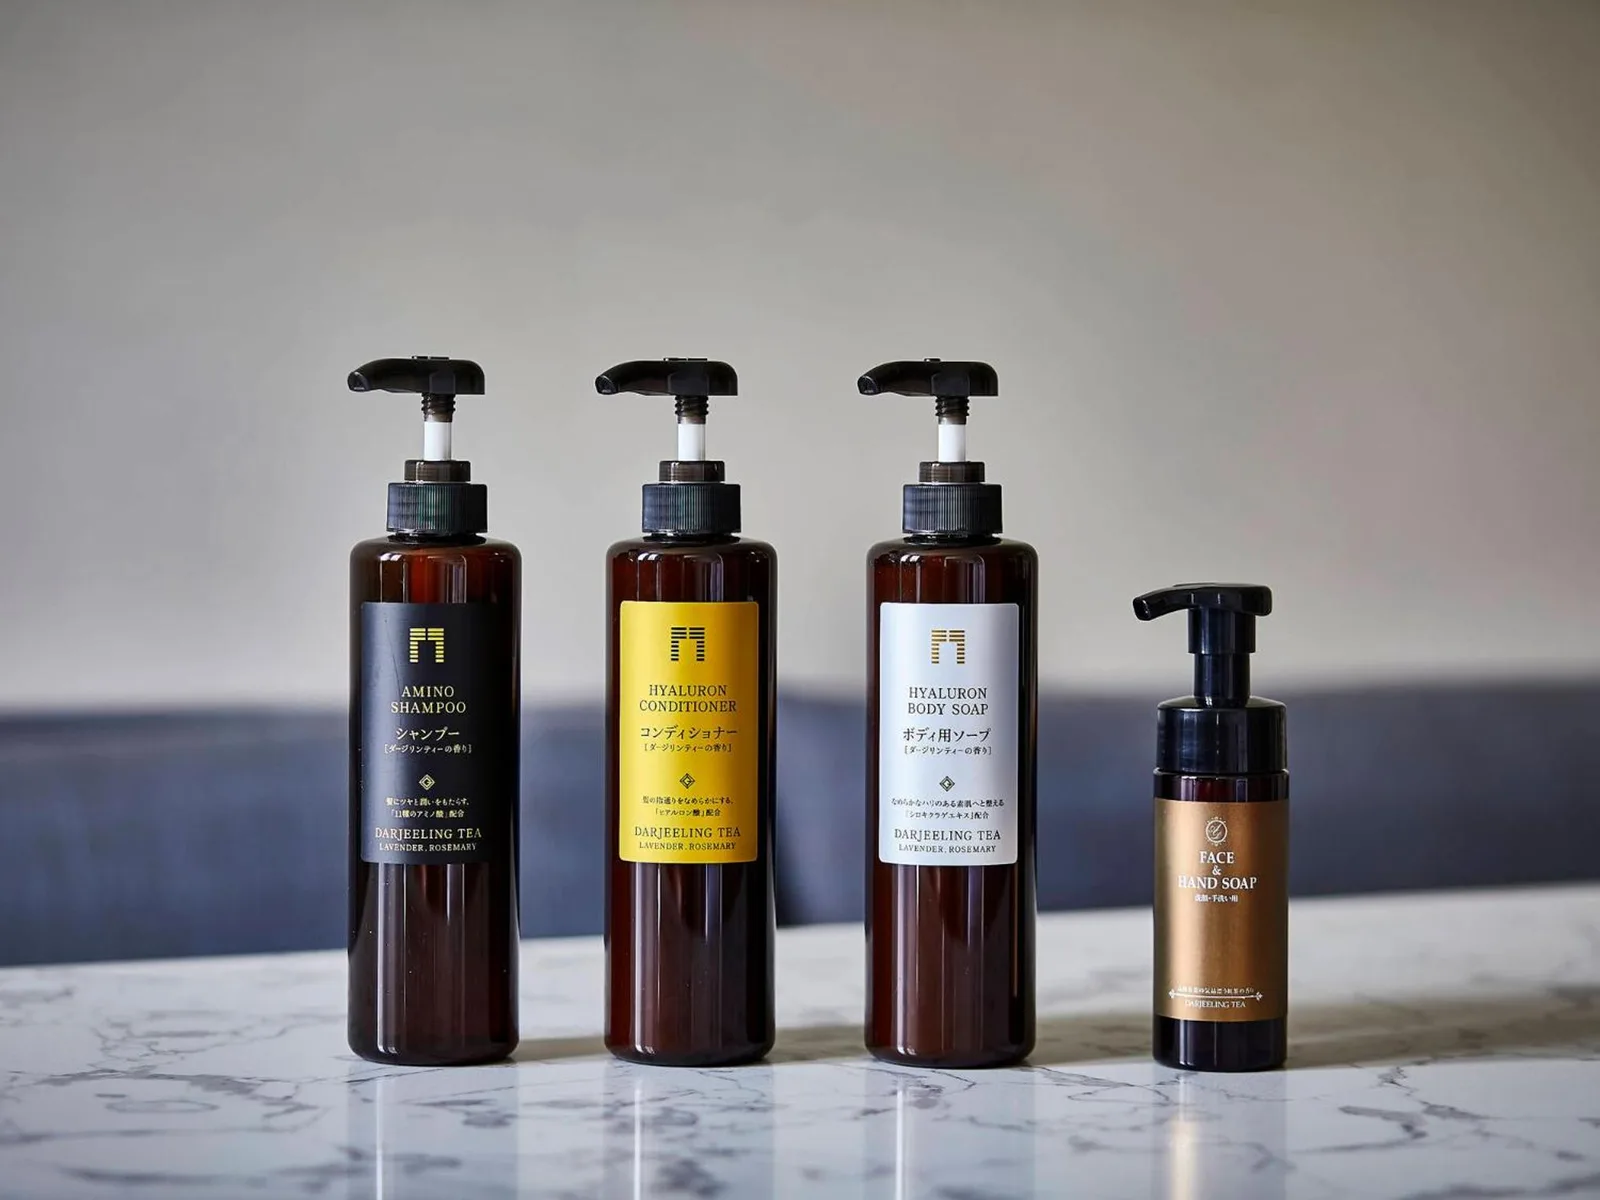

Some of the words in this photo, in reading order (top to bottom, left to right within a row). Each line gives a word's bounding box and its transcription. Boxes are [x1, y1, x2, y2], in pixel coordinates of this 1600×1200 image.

[401, 685, 455, 698] AMINO
[649, 685, 728, 697] HYALURON
[909, 686, 988, 700] HYALURON
[390, 701, 467, 714] SHAMPOO
[639, 700, 737, 713] CONDITIONER
[908, 702, 947, 716] BODY
[951, 703, 989, 716] SOAP
[395, 726, 460, 741] シャンプー
[640, 724, 738, 740] コンディショナー
[902, 726, 992, 743] ボディ用ソープ
[375, 827, 453, 841] DARJEELING
[457, 828, 482, 839] TEA
[634, 826, 713, 839] DARJEELING
[717, 827, 742, 838] TEA
[894, 828, 972, 842] DARJEELING
[976, 830, 1001, 841] TEA
[429, 843, 477, 852] ROSEMARY
[689, 842, 736, 851] ROSEMARY
[948, 845, 997, 854] ROSEMARY
[1200, 851, 1235, 864] FACE
[1212, 865, 1222, 876] &
[1178, 876, 1218, 890] HAND
[1221, 877, 1257, 890] SOAP
[1184, 1001, 1230, 1009] DARJEELING
